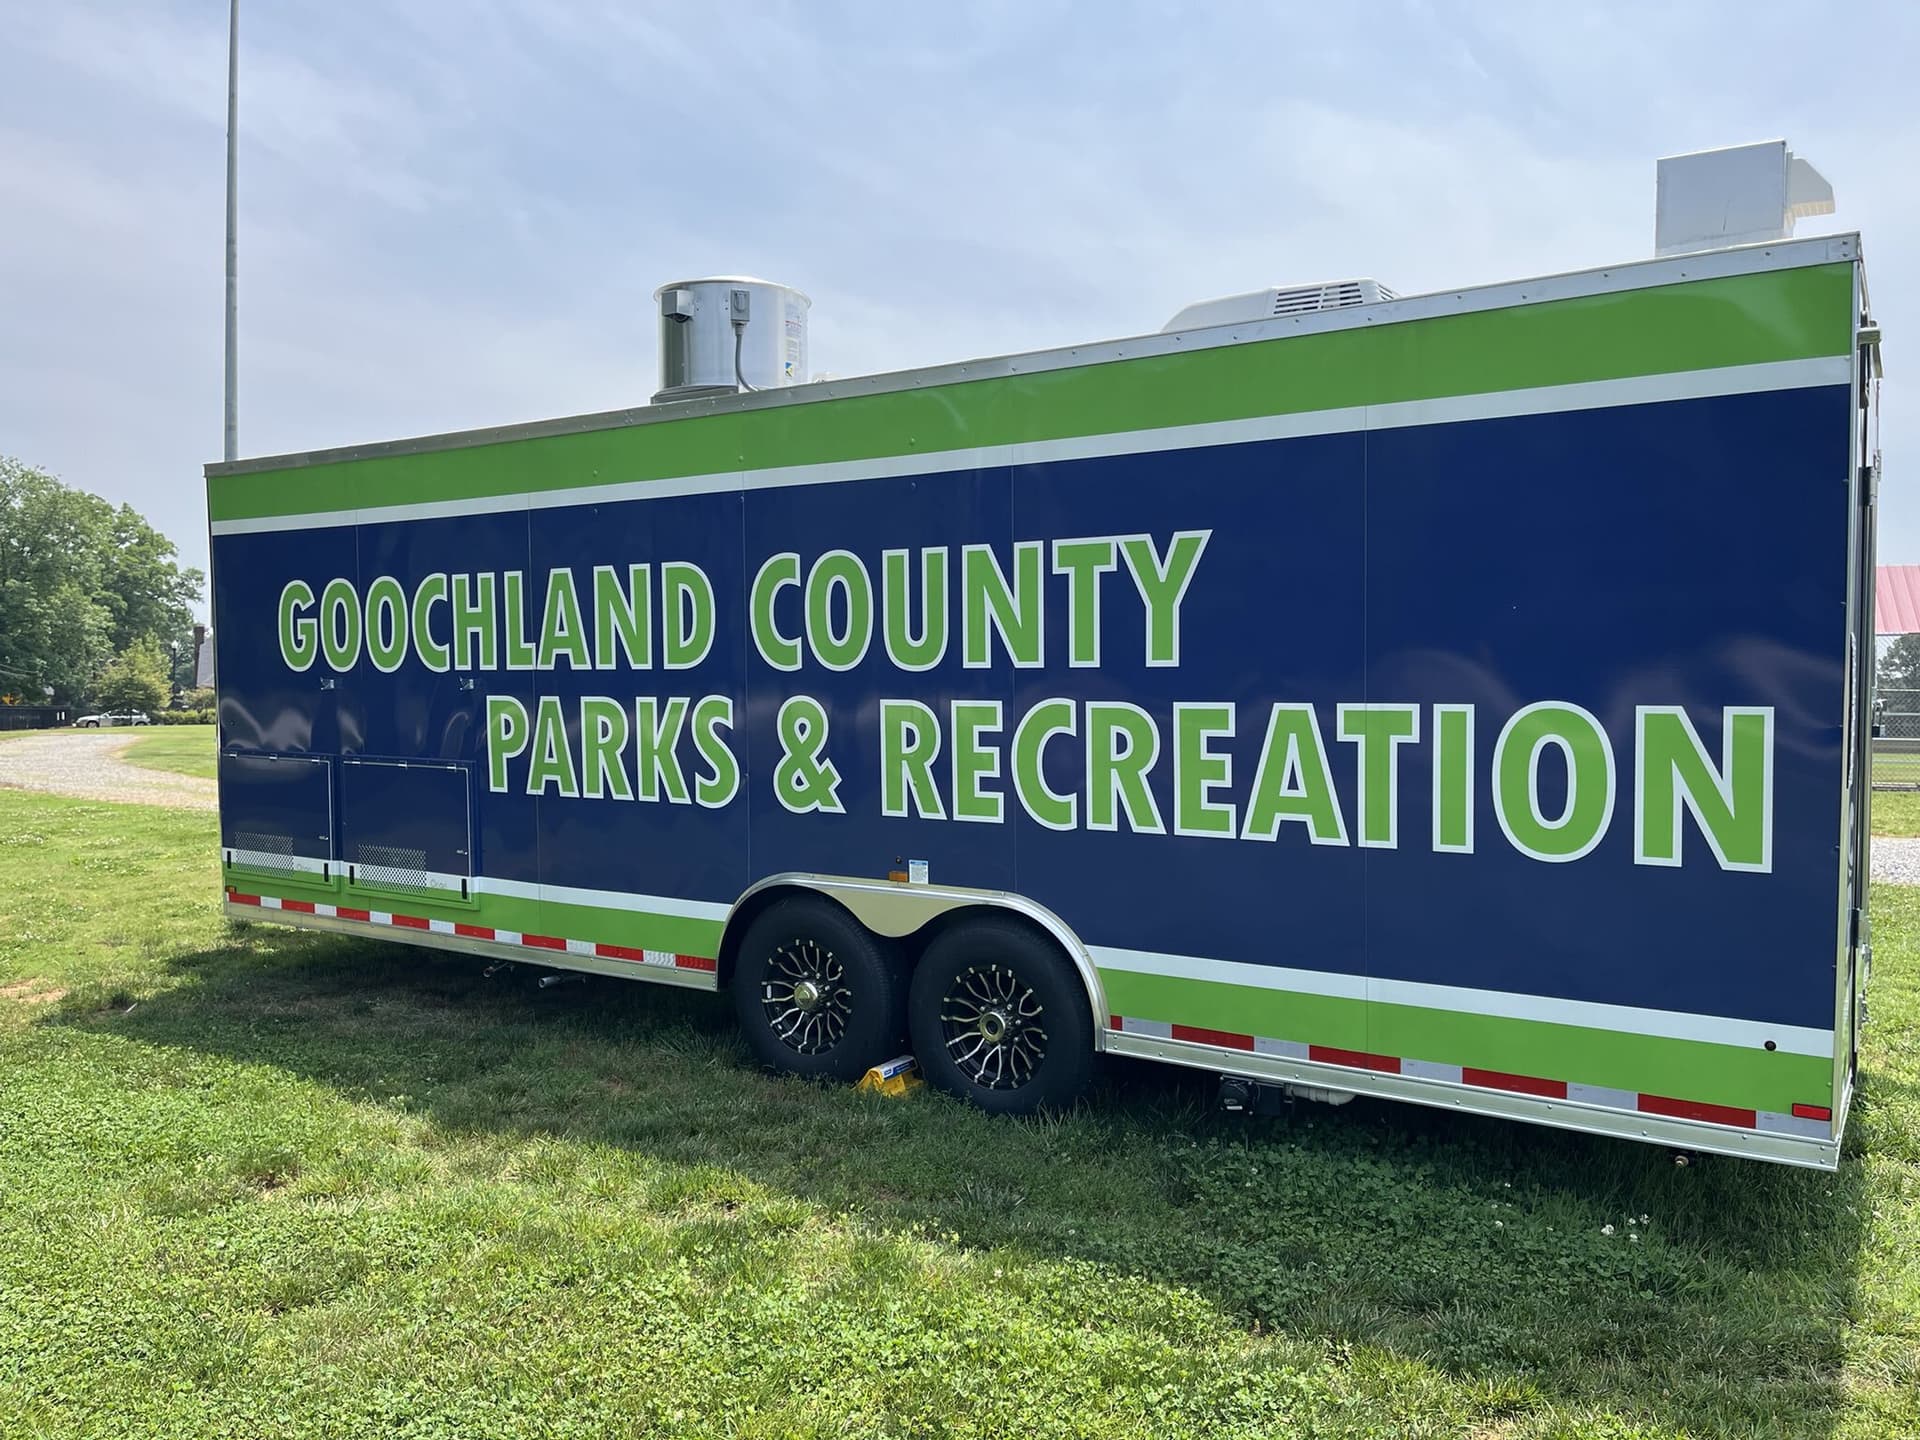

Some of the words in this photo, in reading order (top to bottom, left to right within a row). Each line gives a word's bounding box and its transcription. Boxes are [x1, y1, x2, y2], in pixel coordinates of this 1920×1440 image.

[278, 561, 715, 672] GOOCHLAND
[749, 529, 1213, 672] COUNTY
[486, 695, 740, 808] PARKS
[773, 695, 846, 814] &
[879, 698, 1775, 874] RECREATION
